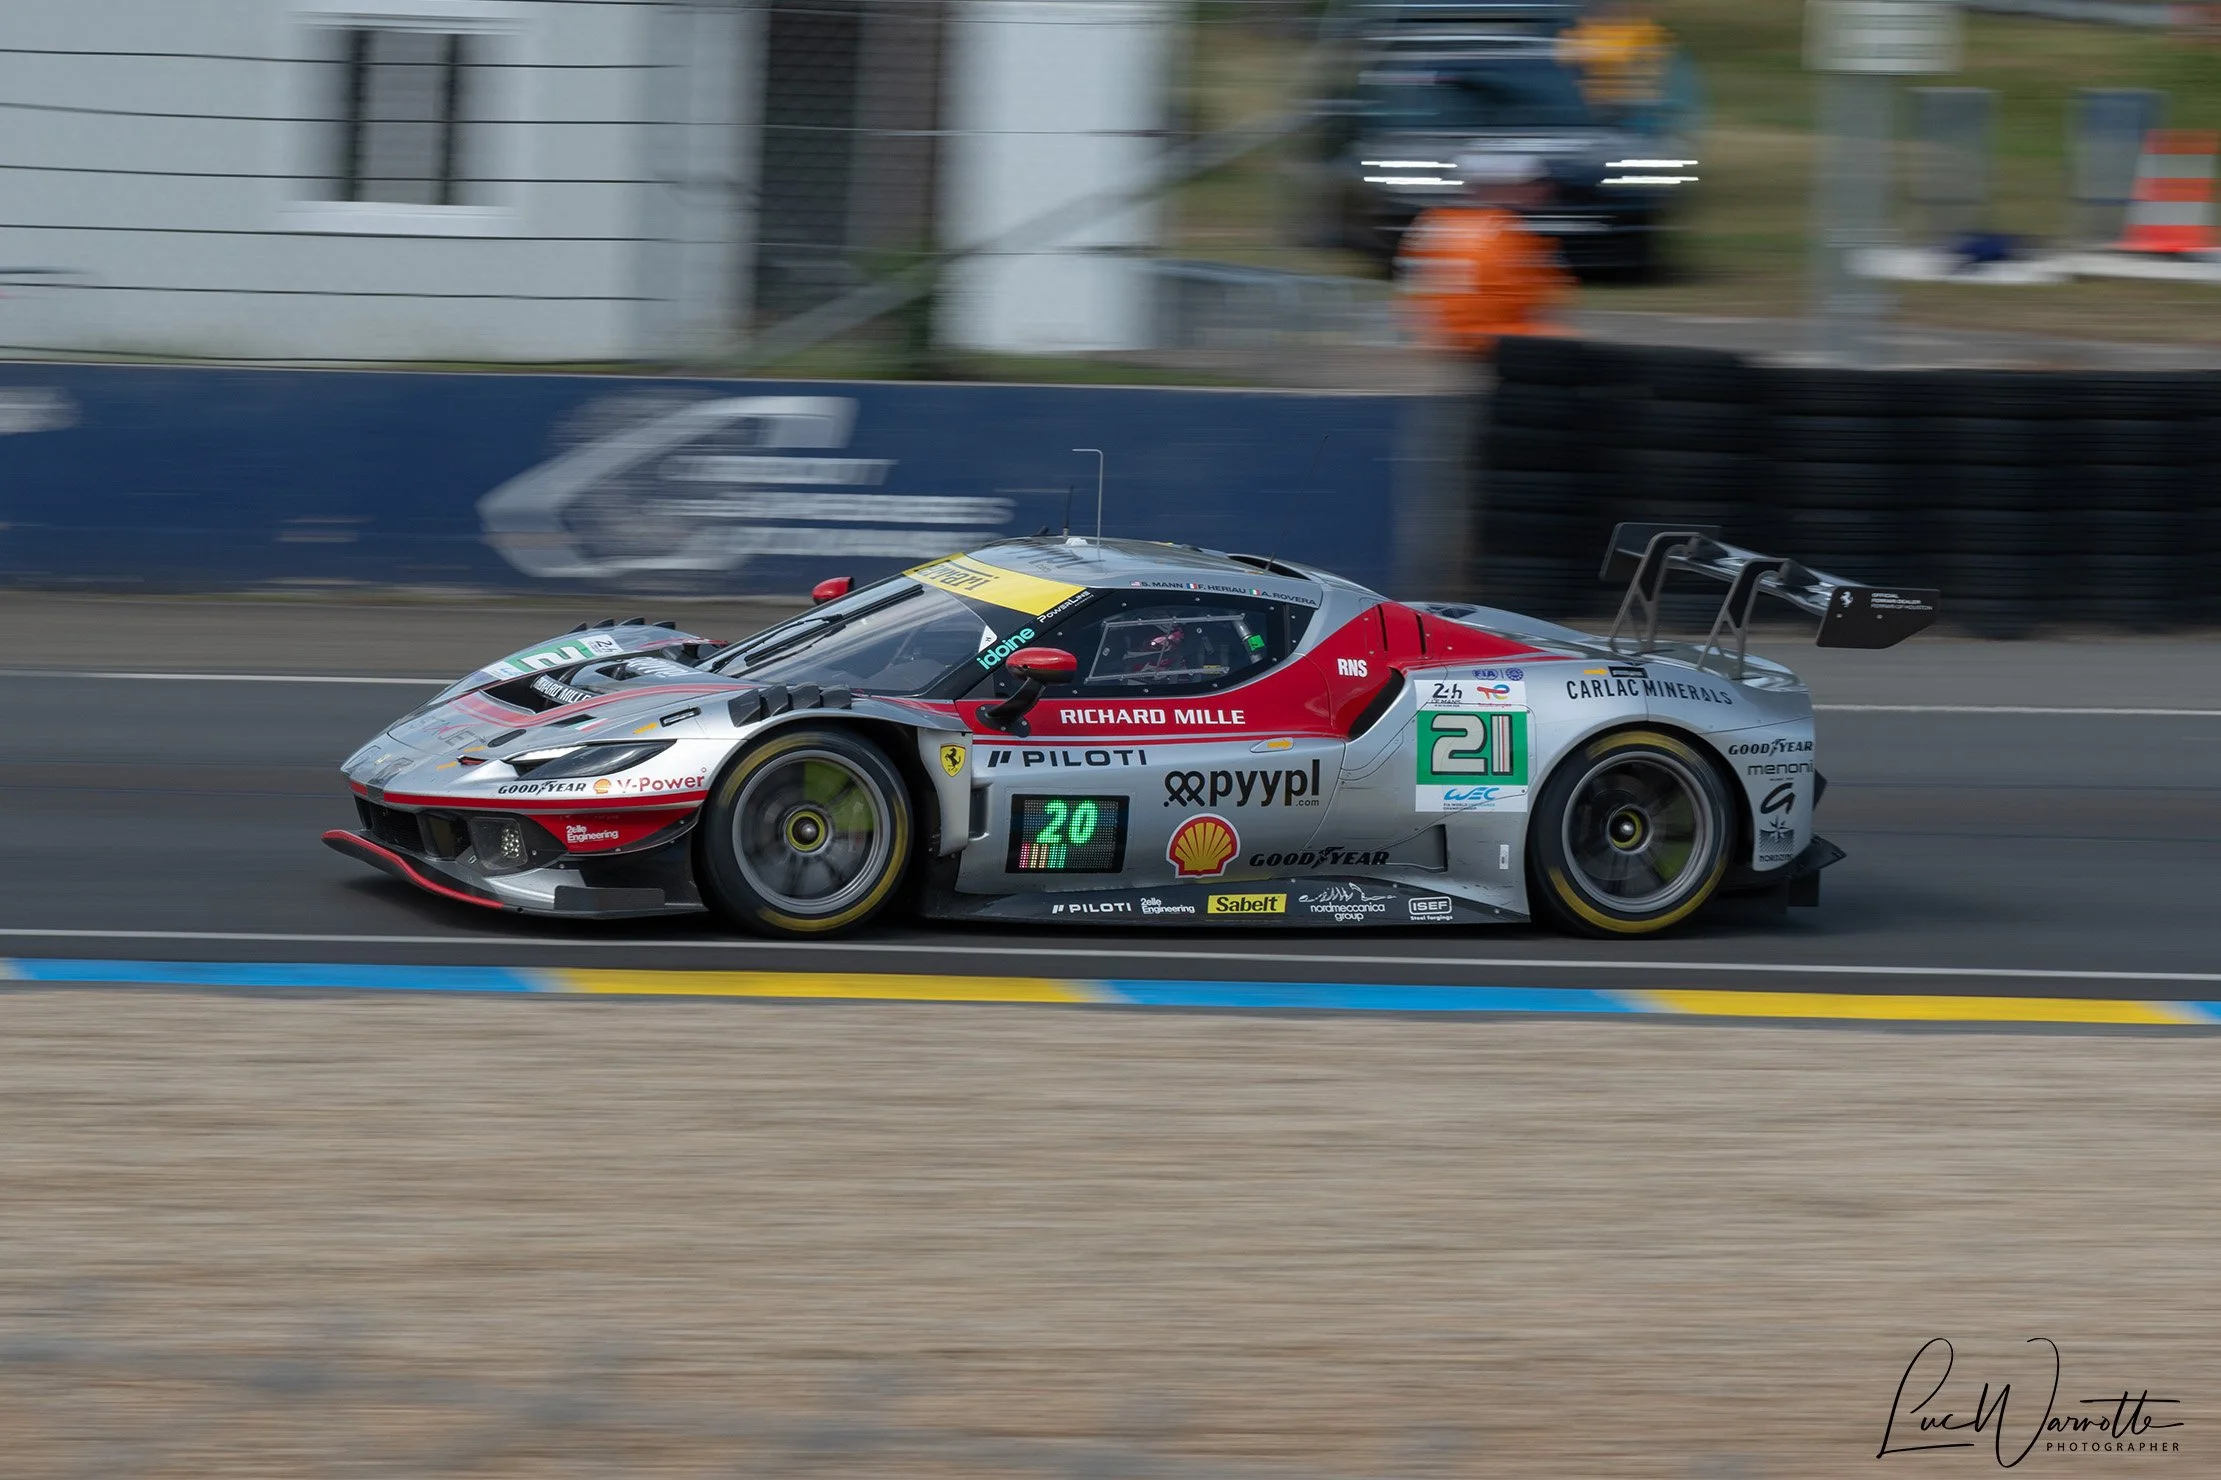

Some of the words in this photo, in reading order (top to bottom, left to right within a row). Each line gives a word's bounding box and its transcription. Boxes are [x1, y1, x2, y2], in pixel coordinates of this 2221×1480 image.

[1207, 585, 1247, 594] HERIAU
[1273, 592, 1317, 606] ROVERA
[977, 627, 1035, 670] idoine
[1337, 658, 1368, 678] RNS
[1432, 683, 1463, 699] 24h
[1566, 679, 1639, 699] CARLAC
[1643, 680, 1733, 705] MINERALS
[1060, 709, 1166, 725] RICHARD
[1174, 709, 1246, 725] MILLE
[1430, 713, 1513, 776] 21
[1728, 739, 1813, 756] GOODYEAR
[1022, 750, 1148, 768] PILOTI
[1748, 760, 1814, 775] menoni
[617, 776, 705, 793] V-Power
[1210, 759, 1320, 808] pyypl
[1443, 787, 1500, 800] WEC
[1036, 800, 1098, 844] 20
[567, 830, 619, 842] Engineering
[1249, 847, 1390, 868] GOODYEAR
[1069, 903, 1132, 913] PILOTI
[1142, 905, 1196, 914] Engineering
[1216, 896, 1278, 912] Sabelt
[1310, 903, 1385, 912] nordmeccanica
[1413, 901, 1448, 911] ISEF
[1335, 911, 1364, 921] group
